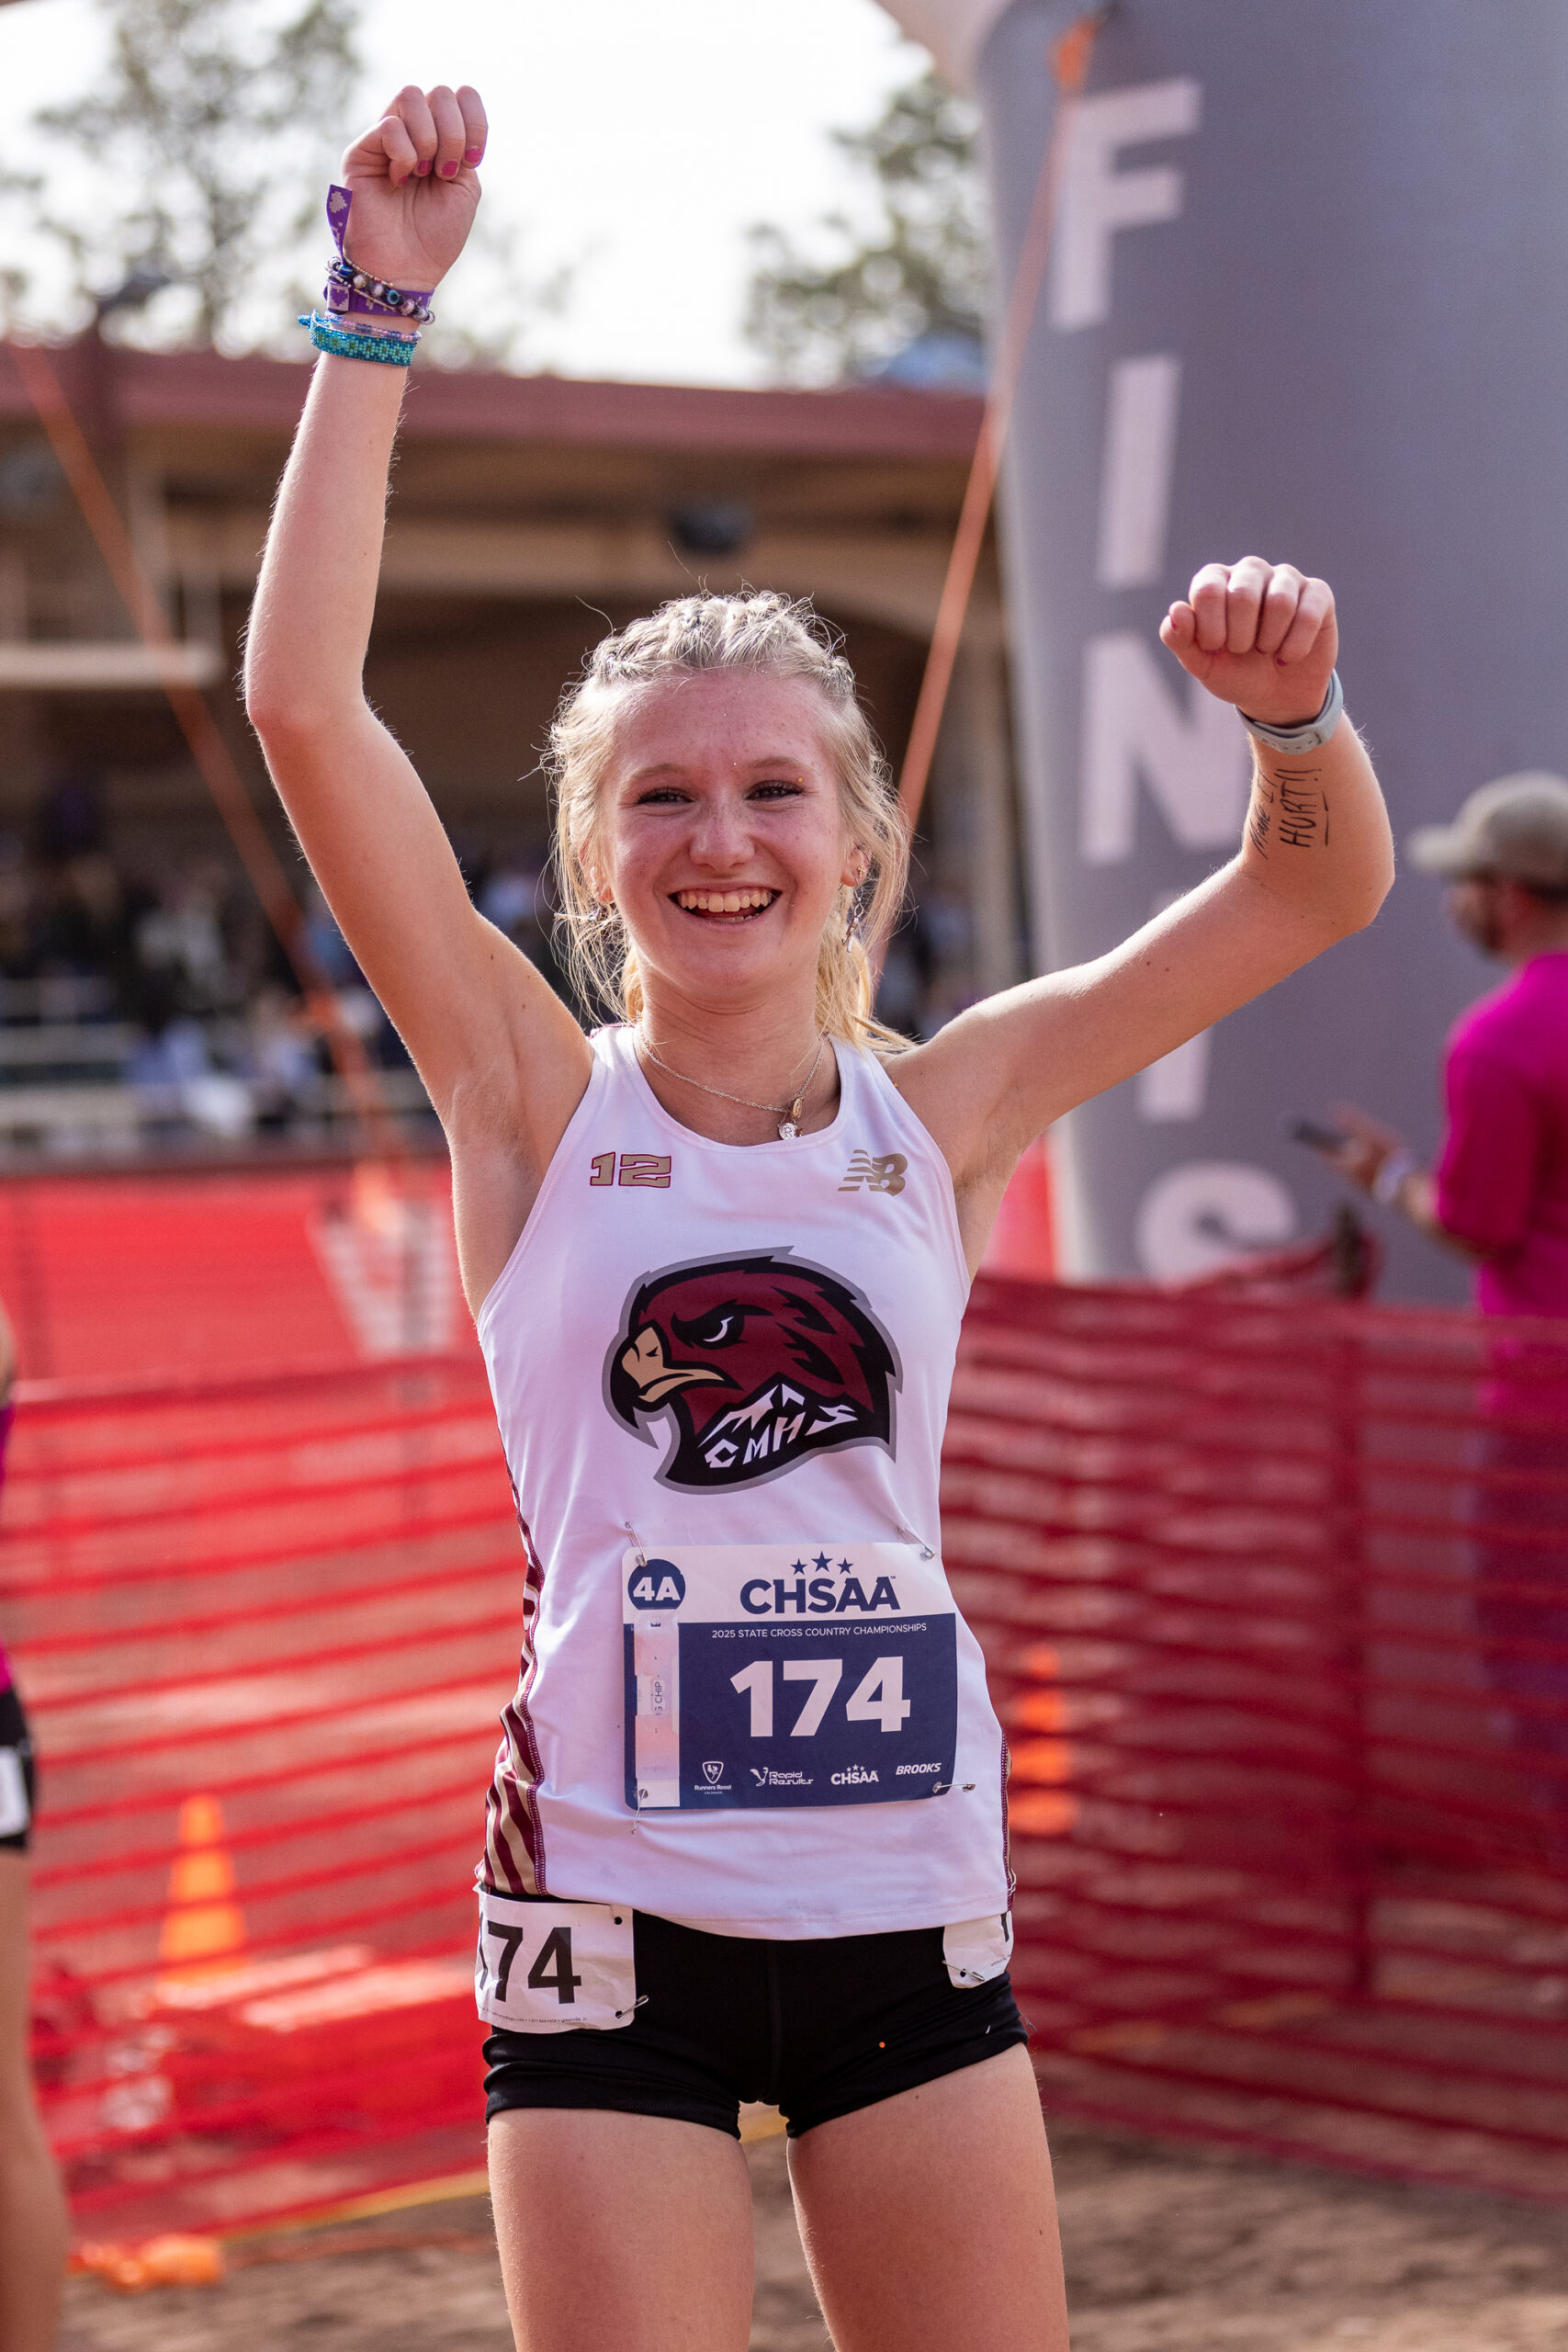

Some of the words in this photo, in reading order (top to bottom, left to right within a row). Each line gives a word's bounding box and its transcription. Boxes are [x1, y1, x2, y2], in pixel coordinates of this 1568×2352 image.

[1274, 768, 1323, 848] HURT!!
[590, 1151, 671, 1188] 12
[704, 1404, 859, 1468] CMHS
[633, 1577, 681, 1601] 4A
[739, 1577, 901, 1614] CHSAA
[712, 1630, 736, 1638] 2025
[738, 1629, 768, 1638] STATE
[770, 1628, 803, 1637] CROSS
[805, 1627, 852, 1636] COUNTRY
[853, 1623, 927, 1635] CHAMPIONSHIPS
[729, 1656, 911, 1737] 174
[769, 1771, 803, 1780] Rapid
[830, 1770, 879, 1785] CHSAA
[896, 1762, 942, 1775] BROOKS
